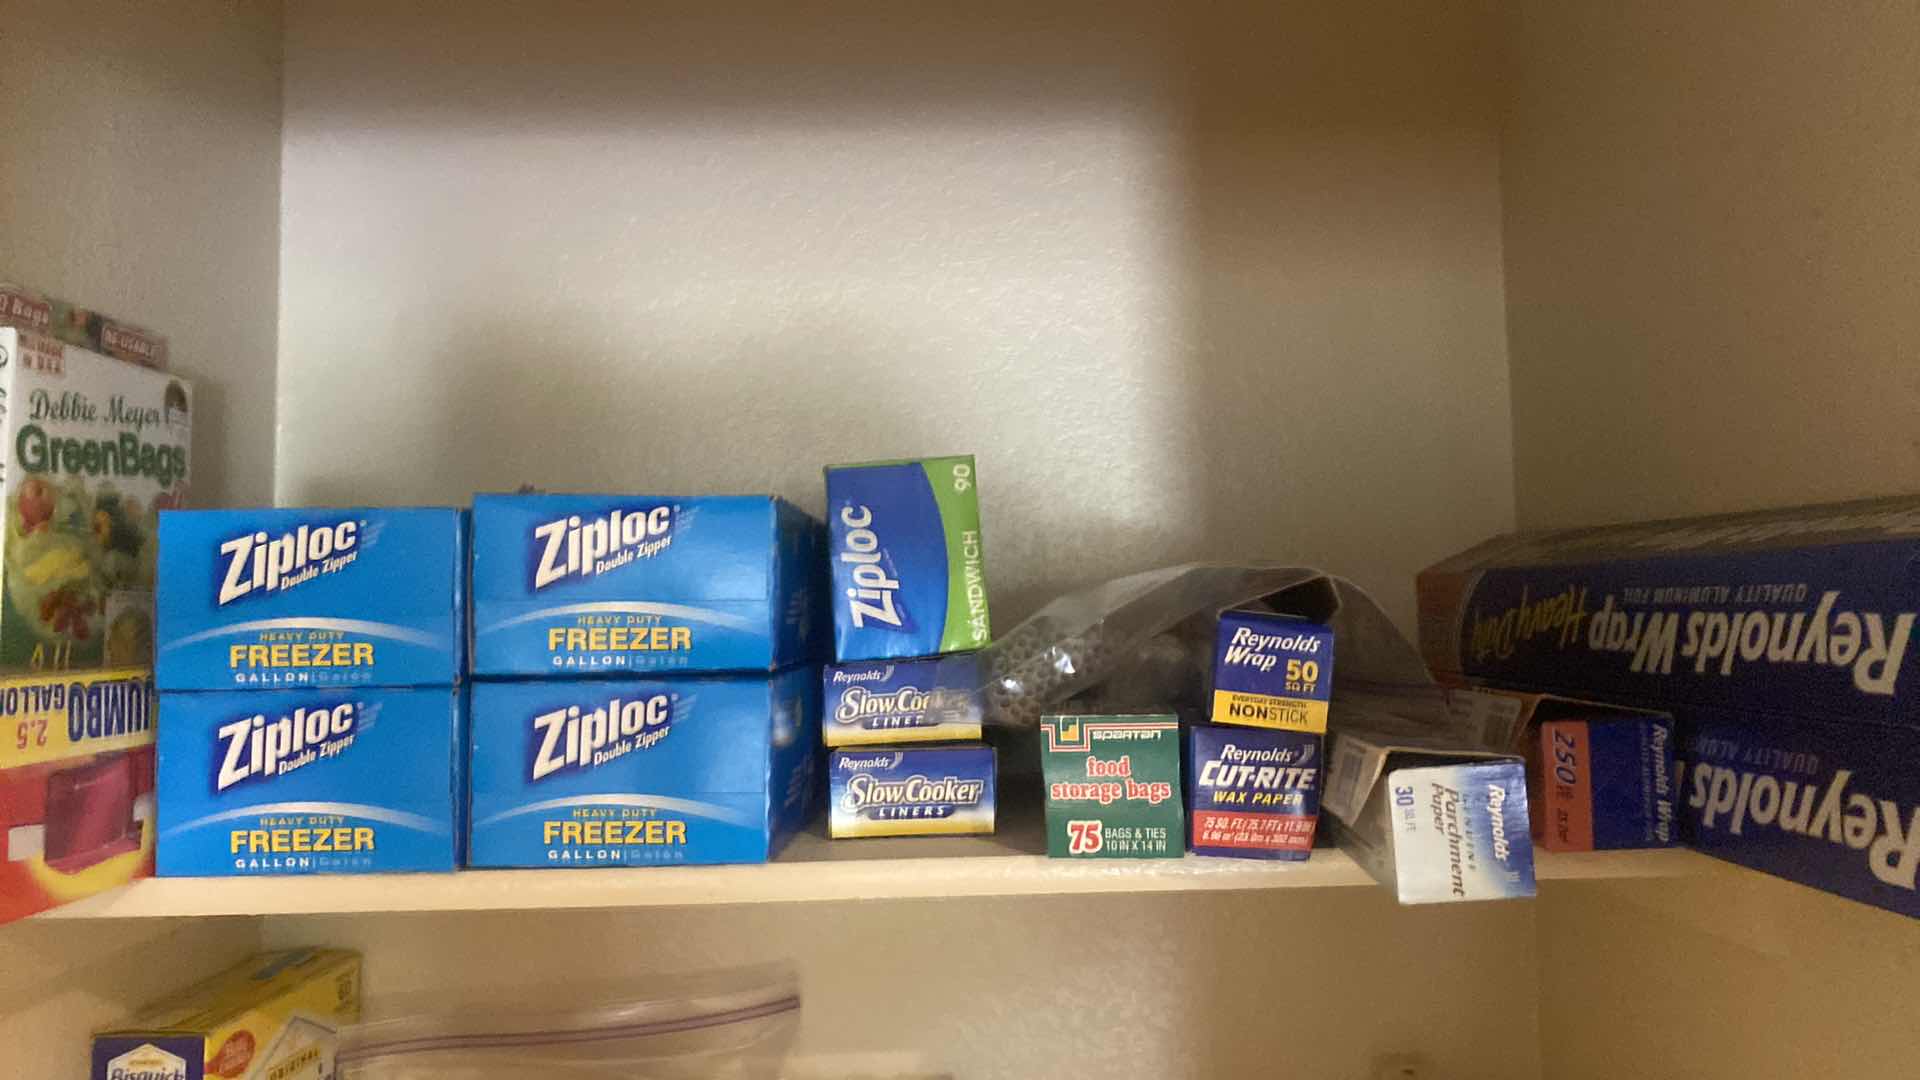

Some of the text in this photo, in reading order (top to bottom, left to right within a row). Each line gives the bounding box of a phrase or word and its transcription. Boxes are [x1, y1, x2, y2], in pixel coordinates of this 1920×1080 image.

[30, 389, 160, 433] Debbie Meyer
[16, 424, 186, 488] GreenBags
[533, 505, 671, 590] Ziploc
[596, 535, 672, 576] Double Zipper
[952, 463, 989, 643] SANDWICH 90
[218, 520, 358, 606] Ziploc
[280, 551, 358, 591] Double Zipper
[840, 504, 903, 629] Ziploc
[1735, 583, 1808, 603] QUALITY
[577, 615, 662, 625] HEAVY DUTY
[1588, 594, 1682, 674] Wrap
[259, 631, 345, 641] HEAVY DUTY
[548, 627, 693, 651] FREEZER
[1231, 627, 1320, 654] Reynolds
[1683, 591, 1919, 695] Reynolds
[229, 643, 375, 669] FREEZER
[552, 656, 626, 667] GALLON
[1224, 645, 1319, 682] Wrap 50
[235, 672, 309, 684] GALLON
[833, 670, 883, 683] Reynolds
[1284, 681, 1317, 693] SQ FT
[837, 687, 896, 723] Slow
[1229, 703, 1309, 724] NONSTICK
[16, 719, 48, 750] 2.5
[217, 703, 354, 791] Ziploc
[532, 694, 668, 781] Ziploc
[593, 725, 671, 767] Double Zipper
[278, 734, 356, 776] Double Zipper
[839, 756, 890, 769] Reynolds
[1087, 754, 1131, 777] food
[1221, 744, 1292, 764] Reynolds
[1553, 727, 1576, 785] 250
[843, 774, 905, 812] Slow
[905, 775, 983, 805] Cooker
[1051, 778, 1172, 805] storage bags
[1395, 786, 1414, 807] 30
[1653, 724, 1673, 843] Reynolds Wrap
[572, 807, 657, 818] HEAVY DUTY
[879, 806, 945, 817] LINERS
[1213, 791, 1304, 806] WAX PAPER
[1431, 782, 1444, 835] Paper
[259, 815, 345, 826] HEAVY DUTY
[543, 820, 688, 846] FREEZER
[1487, 783, 1510, 862] Reynolds
[1689, 761, 1920, 890] Reynolds
[230, 827, 376, 854] FREEZER
[1067, 820, 1166, 855] 75 BAGS & TIES
[1105, 840, 1167, 852] 10 IN X 14 IN
[1445, 786, 1465, 898] Parchment
[235, 857, 310, 869] GALLON
[547, 849, 622, 860] GALLON
